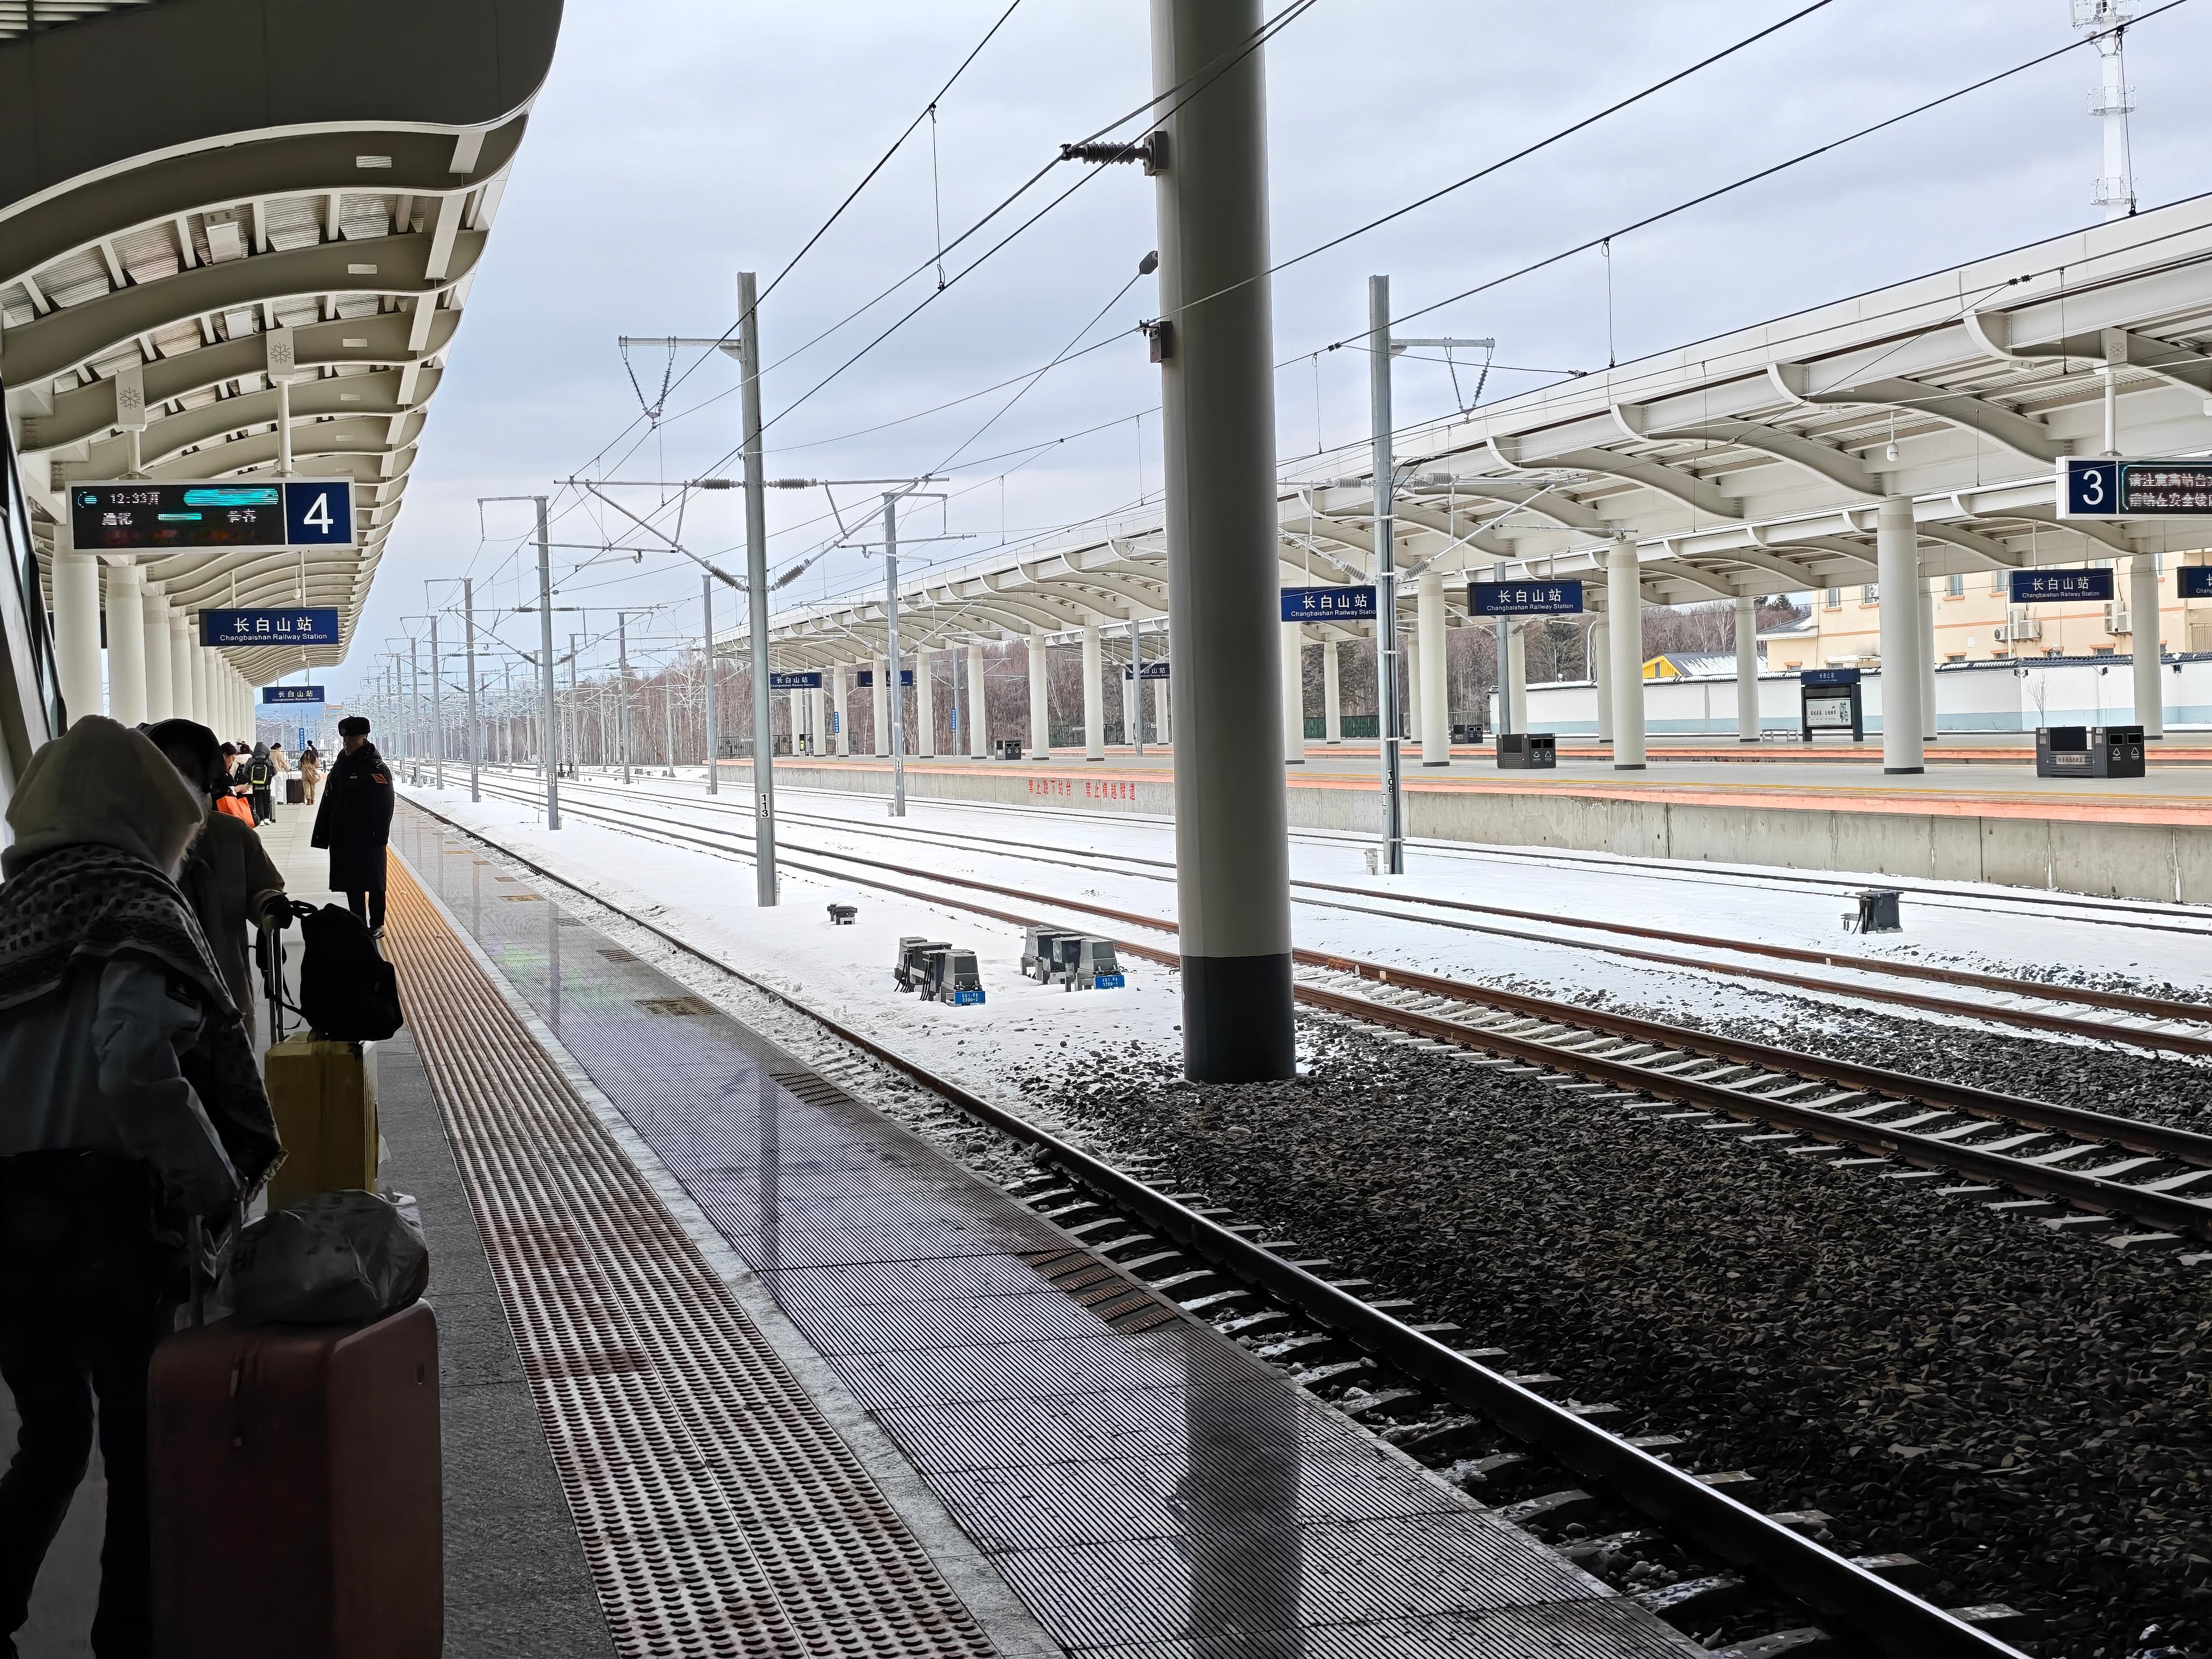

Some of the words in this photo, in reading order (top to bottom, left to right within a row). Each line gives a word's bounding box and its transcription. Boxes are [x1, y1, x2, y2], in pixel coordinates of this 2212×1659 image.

[2082, 470, 2103, 505] 3
[304, 493, 334, 534] 4
[2032, 577, 2089, 591] 长白山站
[1302, 594, 1367, 609] 长白山站
[1498, 588, 1561, 603] 长白山站
[233, 616, 313, 633] 长白山站
[220, 634, 271, 642] Changbaishan
[278, 690, 313, 698] 长白山站
